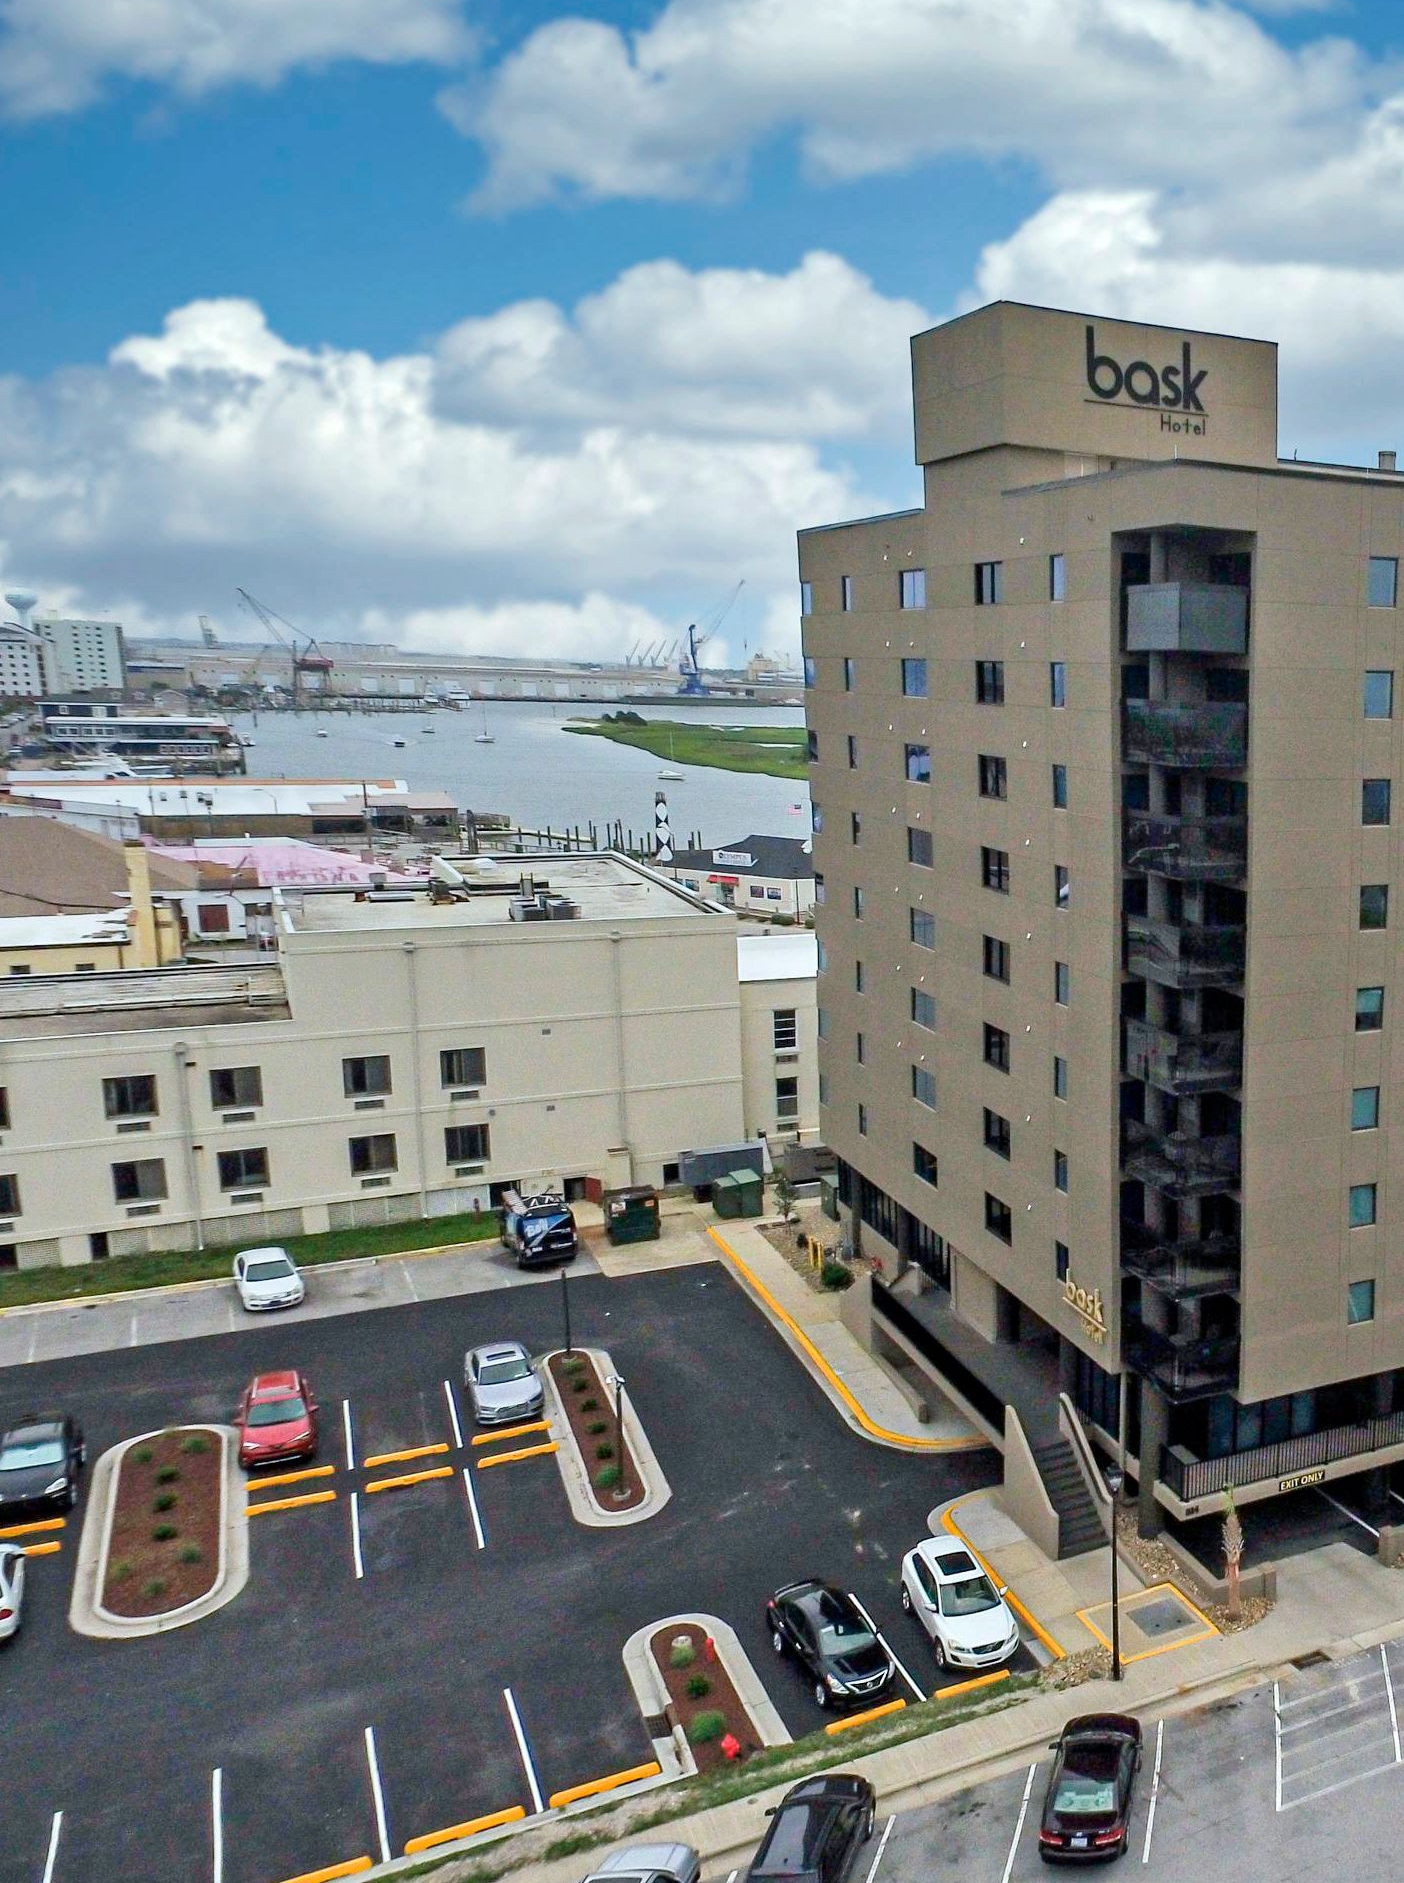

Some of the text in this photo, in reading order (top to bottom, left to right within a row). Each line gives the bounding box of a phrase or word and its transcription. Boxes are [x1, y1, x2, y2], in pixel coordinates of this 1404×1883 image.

[1086, 325, 1208, 412] bask
[1160, 413, 1206, 436] Hotel
[1065, 1268, 1104, 1323] bask
[1280, 1471, 1324, 1491] EXIT ONLY
